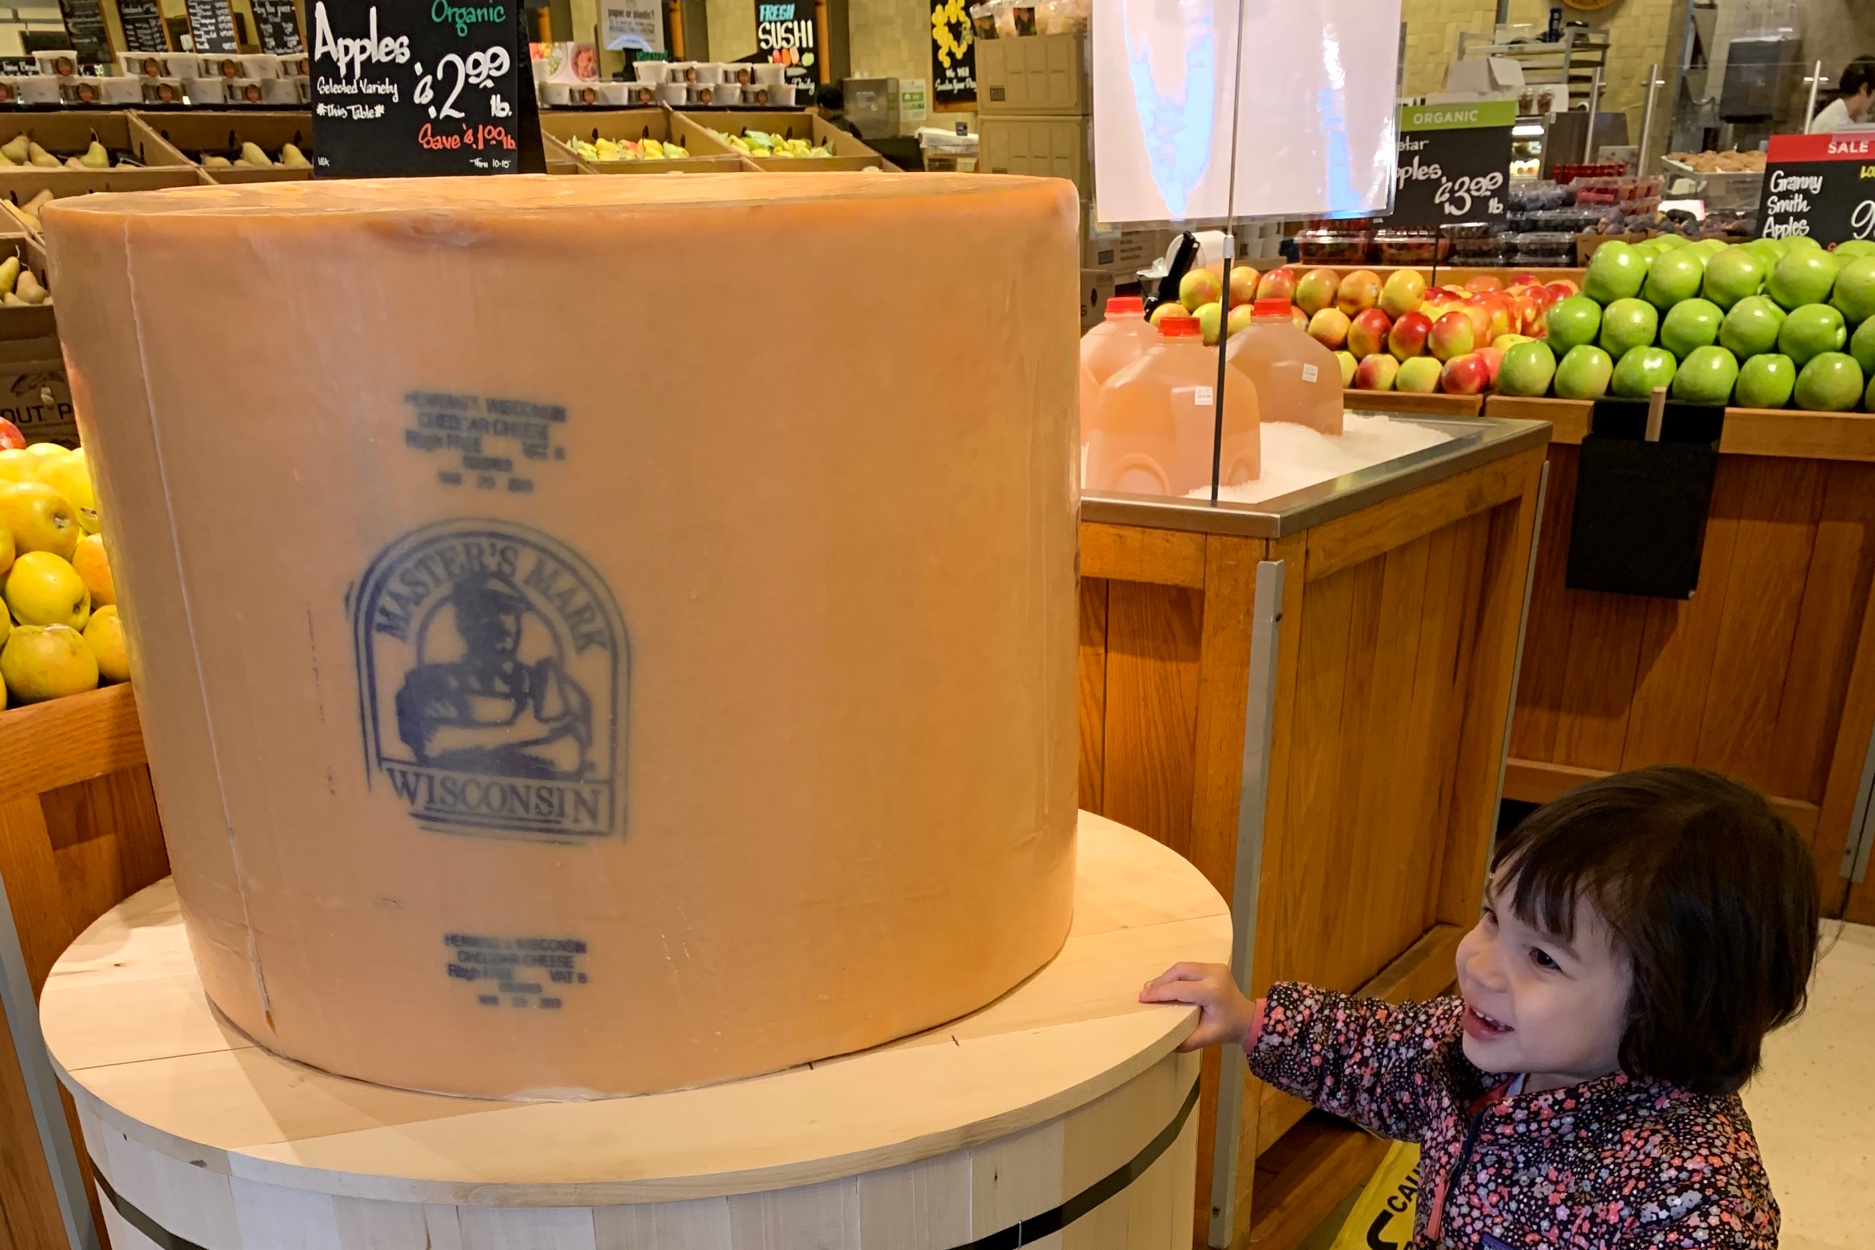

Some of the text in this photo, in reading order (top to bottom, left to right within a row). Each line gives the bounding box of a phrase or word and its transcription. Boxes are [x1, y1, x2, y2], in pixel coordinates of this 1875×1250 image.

[431, 0, 507, 37] Organic
[759, 4, 795, 21] FRESH
[314, 1, 411, 80] Apples
[758, 20, 814, 49] SUSHI
[316, 76, 399, 103] Selected Variety
[1413, 110, 1479, 125] ORGANIC
[418, 123, 461, 149] Save
[1827, 141, 1869, 154] SALE
[1396, 155, 1442, 190] ples
[1770, 170, 1823, 194] Granny
[1767, 193, 1811, 215] Smith
[1762, 216, 1810, 240] Apples
[375, 540, 612, 657] MASTER'S MARK
[385, 766, 604, 828] WISCONSIN
